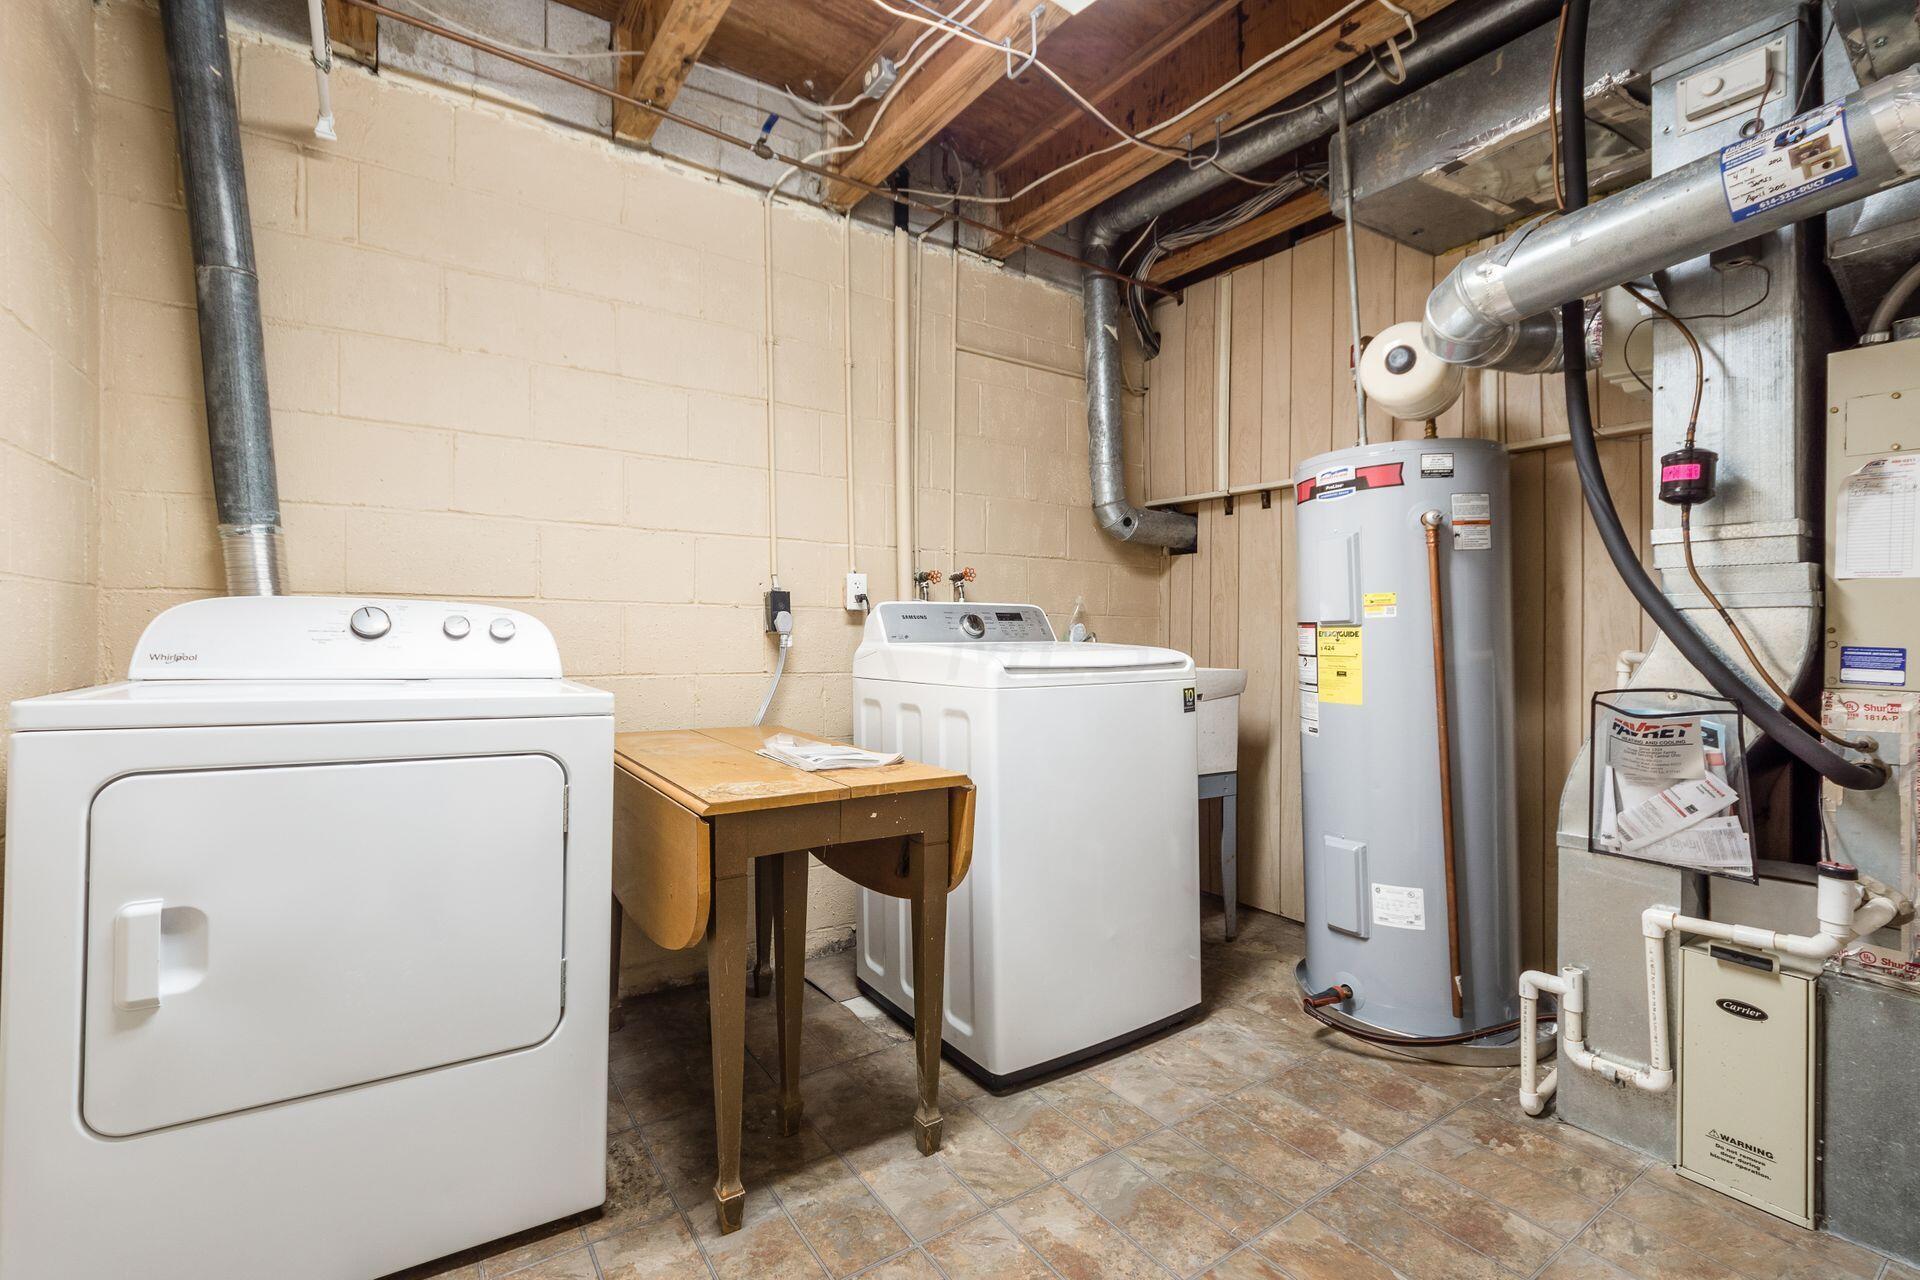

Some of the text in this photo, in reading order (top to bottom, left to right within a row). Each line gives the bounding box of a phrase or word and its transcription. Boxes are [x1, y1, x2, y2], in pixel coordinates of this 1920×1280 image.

[149, 652, 198, 664] Whirlpool
[1184, 689, 1194, 702] 10
[1612, 717, 1692, 738] FAVRET
[1722, 1001, 1762, 1017] Carrier
[1720, 1133, 1774, 1160] WARNING
[1709, 1152, 1733, 1165] blower
[1720, 1151, 1761, 1171] door during
[1726, 1147, 1738, 1155] not
[1740, 1153, 1766, 1167] remove
